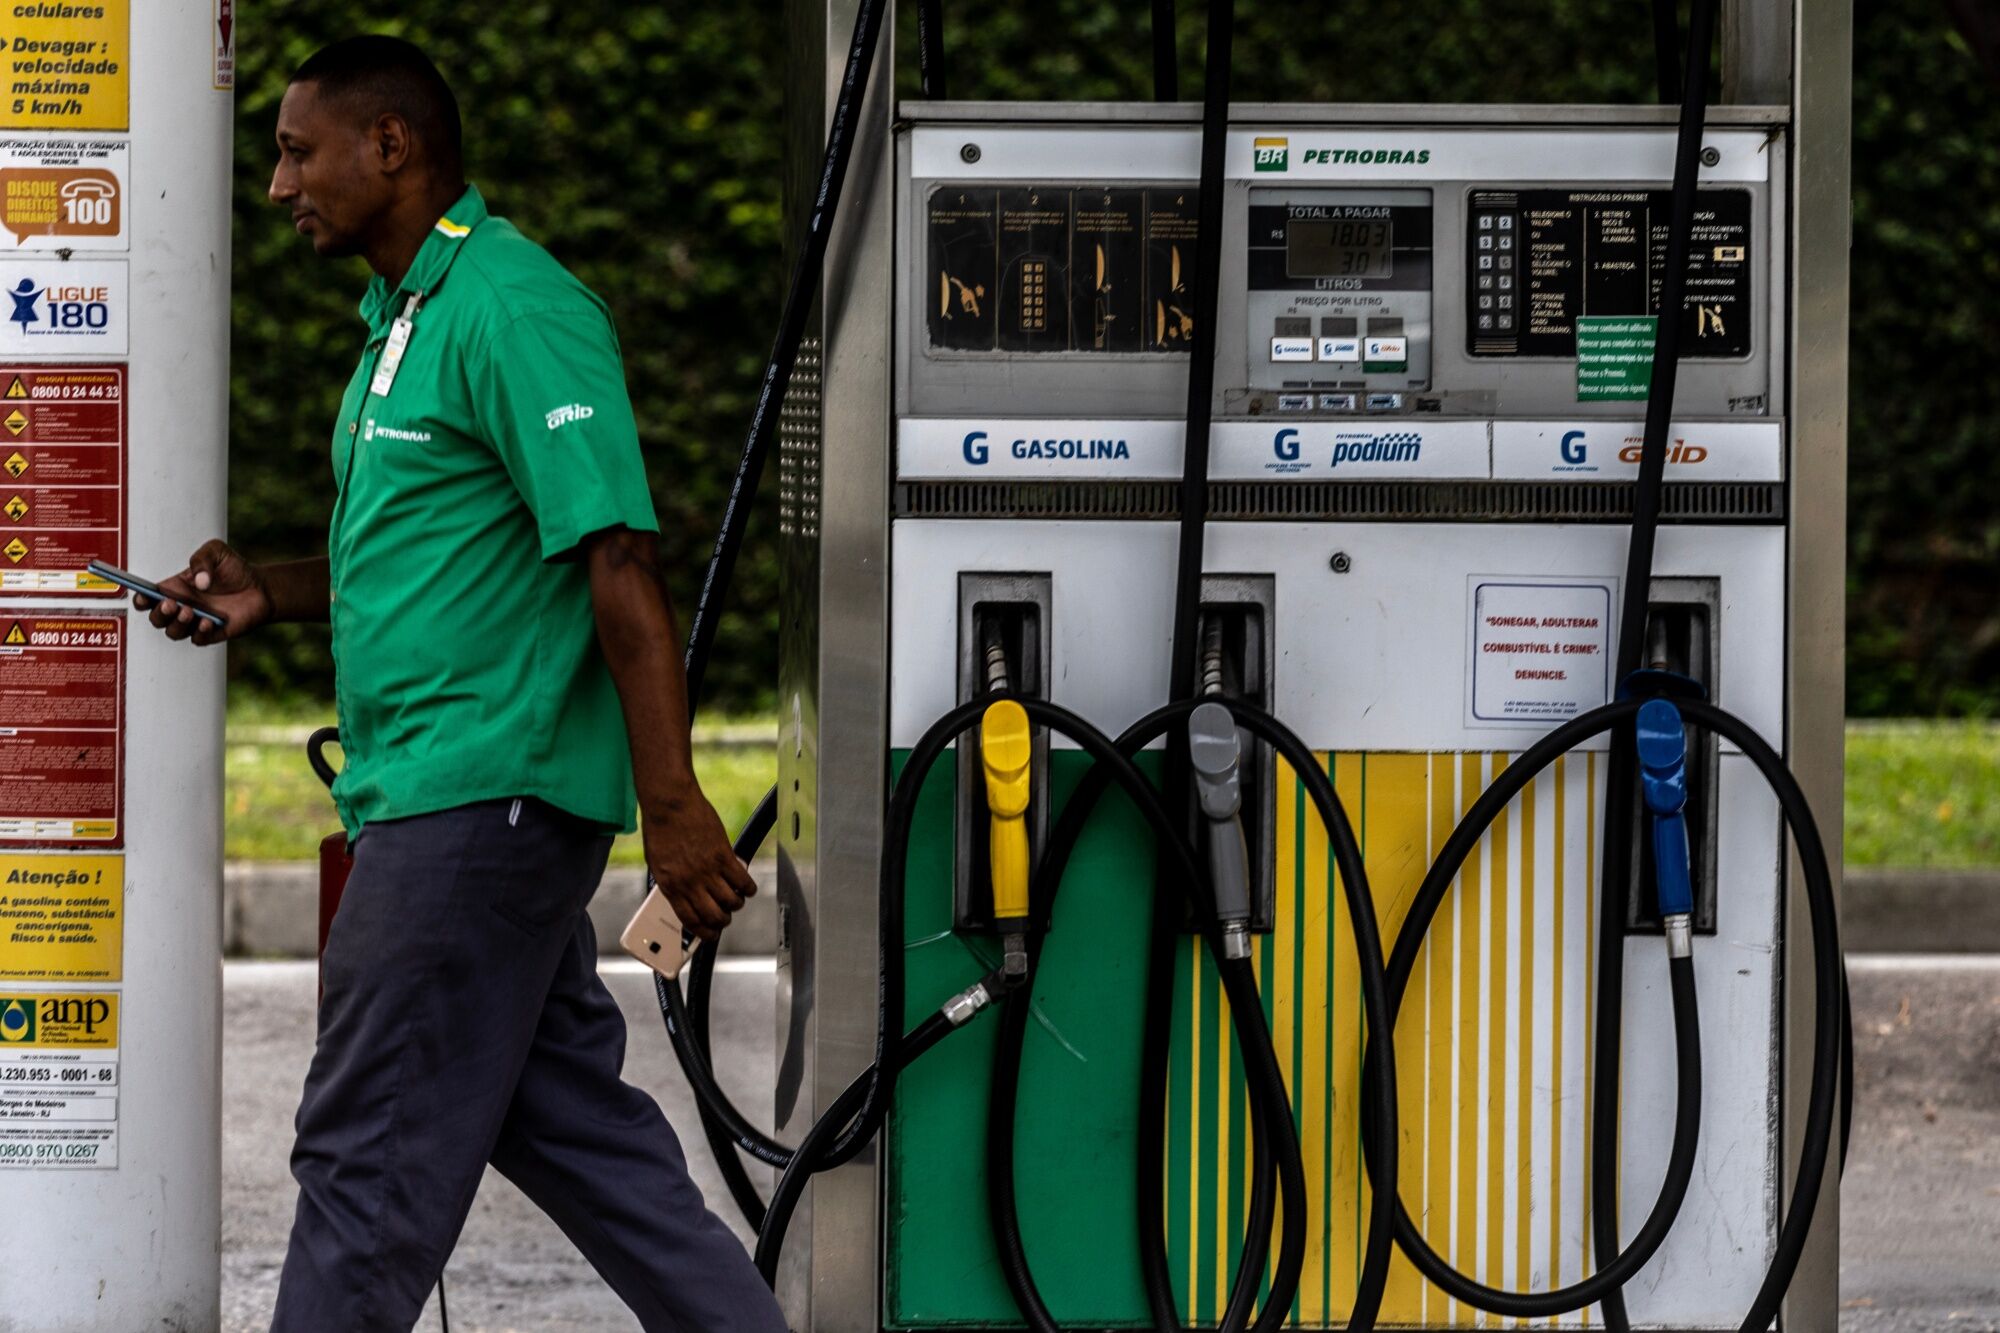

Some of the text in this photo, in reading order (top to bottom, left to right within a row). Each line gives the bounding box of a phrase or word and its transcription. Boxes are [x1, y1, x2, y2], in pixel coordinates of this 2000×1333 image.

[13, 2, 104, 19] celulares
[12, 37, 96, 56] Devagar
[12, 58, 118, 74] velocidade
[12, 78, 90, 95] máxima
[12, 99, 82, 115] 5 km/h
[1256, 149, 1431, 164] BR PETROBRAS
[7, 181, 57, 196] DISQUE
[7, 198, 58, 211] DIREITOS
[1031, 194, 1039, 205] 2
[7, 211, 57, 223] HUMANOS
[64, 199, 111, 225] 100
[1288, 207, 1391, 219] TOTAL A PAGAR
[1271, 230, 1284, 240] R$
[1315, 278, 1362, 290] LITROS
[46, 287, 108, 302] LIGUE
[1295, 297, 1383, 307] PREÇO POR LITRO
[47, 303, 108, 328] 180
[32, 386, 119, 398] 0800 0 24 44 33
[375, 426, 432, 442] PETROBRAS
[963, 431, 1130, 465] G GASOLINA
[1274, 428, 1300, 461] G
[1331, 433, 1423, 468] podium
[1560, 430, 1587, 464] G
[35, 622, 64, 630] DISQUE
[1541, 617, 1599, 629] ADULTERAR
[30, 632, 118, 645] 0800 0 24 44 33
[1483, 642, 1551, 654] COMBUSTÍVEL
[1554, 642, 1560, 654] É
[1515, 669, 1567, 680] DENUNCIE.
[6, 869, 90, 888] Atenção
[0, 896, 110, 907] A gasolina contém
[51, 909, 115, 918] substância
[16, 922, 93, 932] cancerígena.
[10, 933, 44, 943] Risco
[58, 933, 98, 943] saúde.
[41, 998, 109, 1034] anp
[0, 1068, 51, 1081] .230.953
[61, 1069, 88, 1081] 0001
[99, 1068, 112, 1081] 68
[35, 1100, 66, 1108] Medeiros
[0, 1144, 99, 1158] 0800 970 0267
